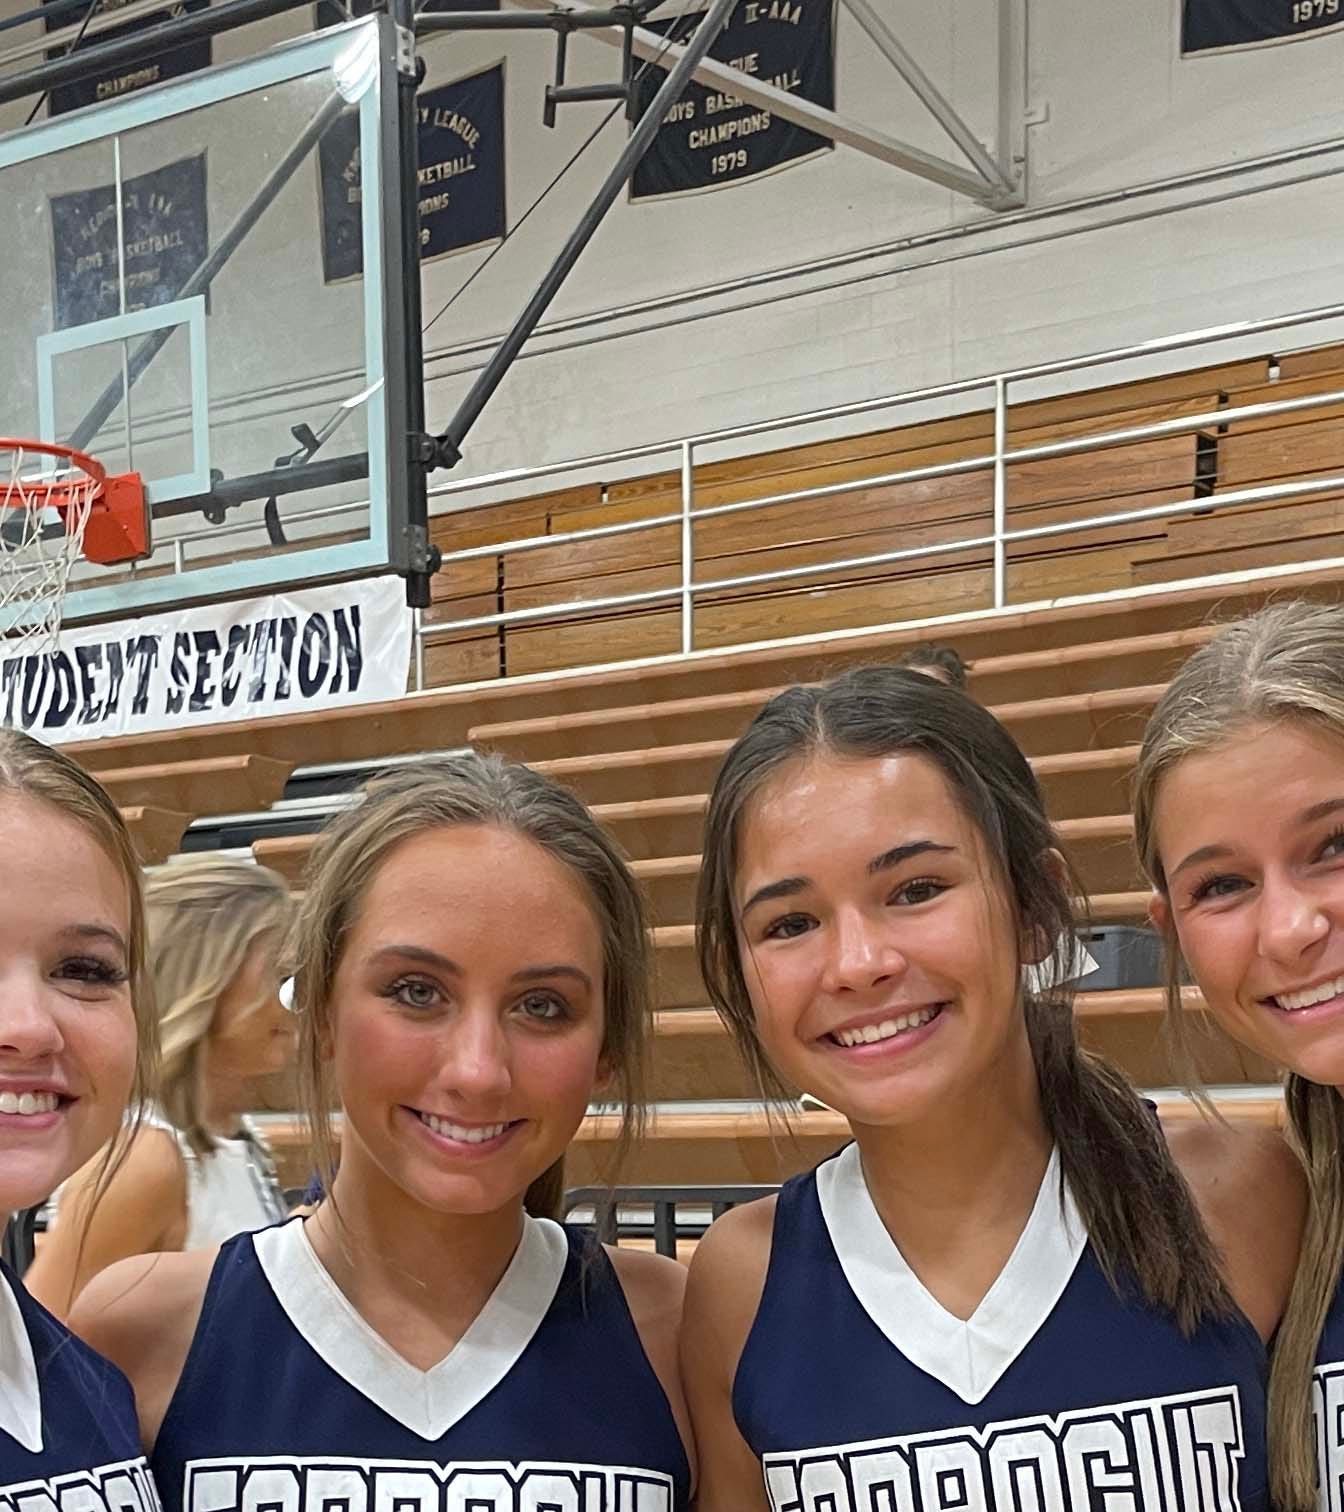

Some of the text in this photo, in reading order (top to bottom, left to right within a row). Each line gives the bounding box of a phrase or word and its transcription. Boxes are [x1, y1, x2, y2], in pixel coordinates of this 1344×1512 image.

[434, 108, 480, 149] LEAGUE
[688, 111, 771, 149] CHAMPIONS
[711, 149, 747, 175] 1979
[165, 604, 364, 716] SECTION
